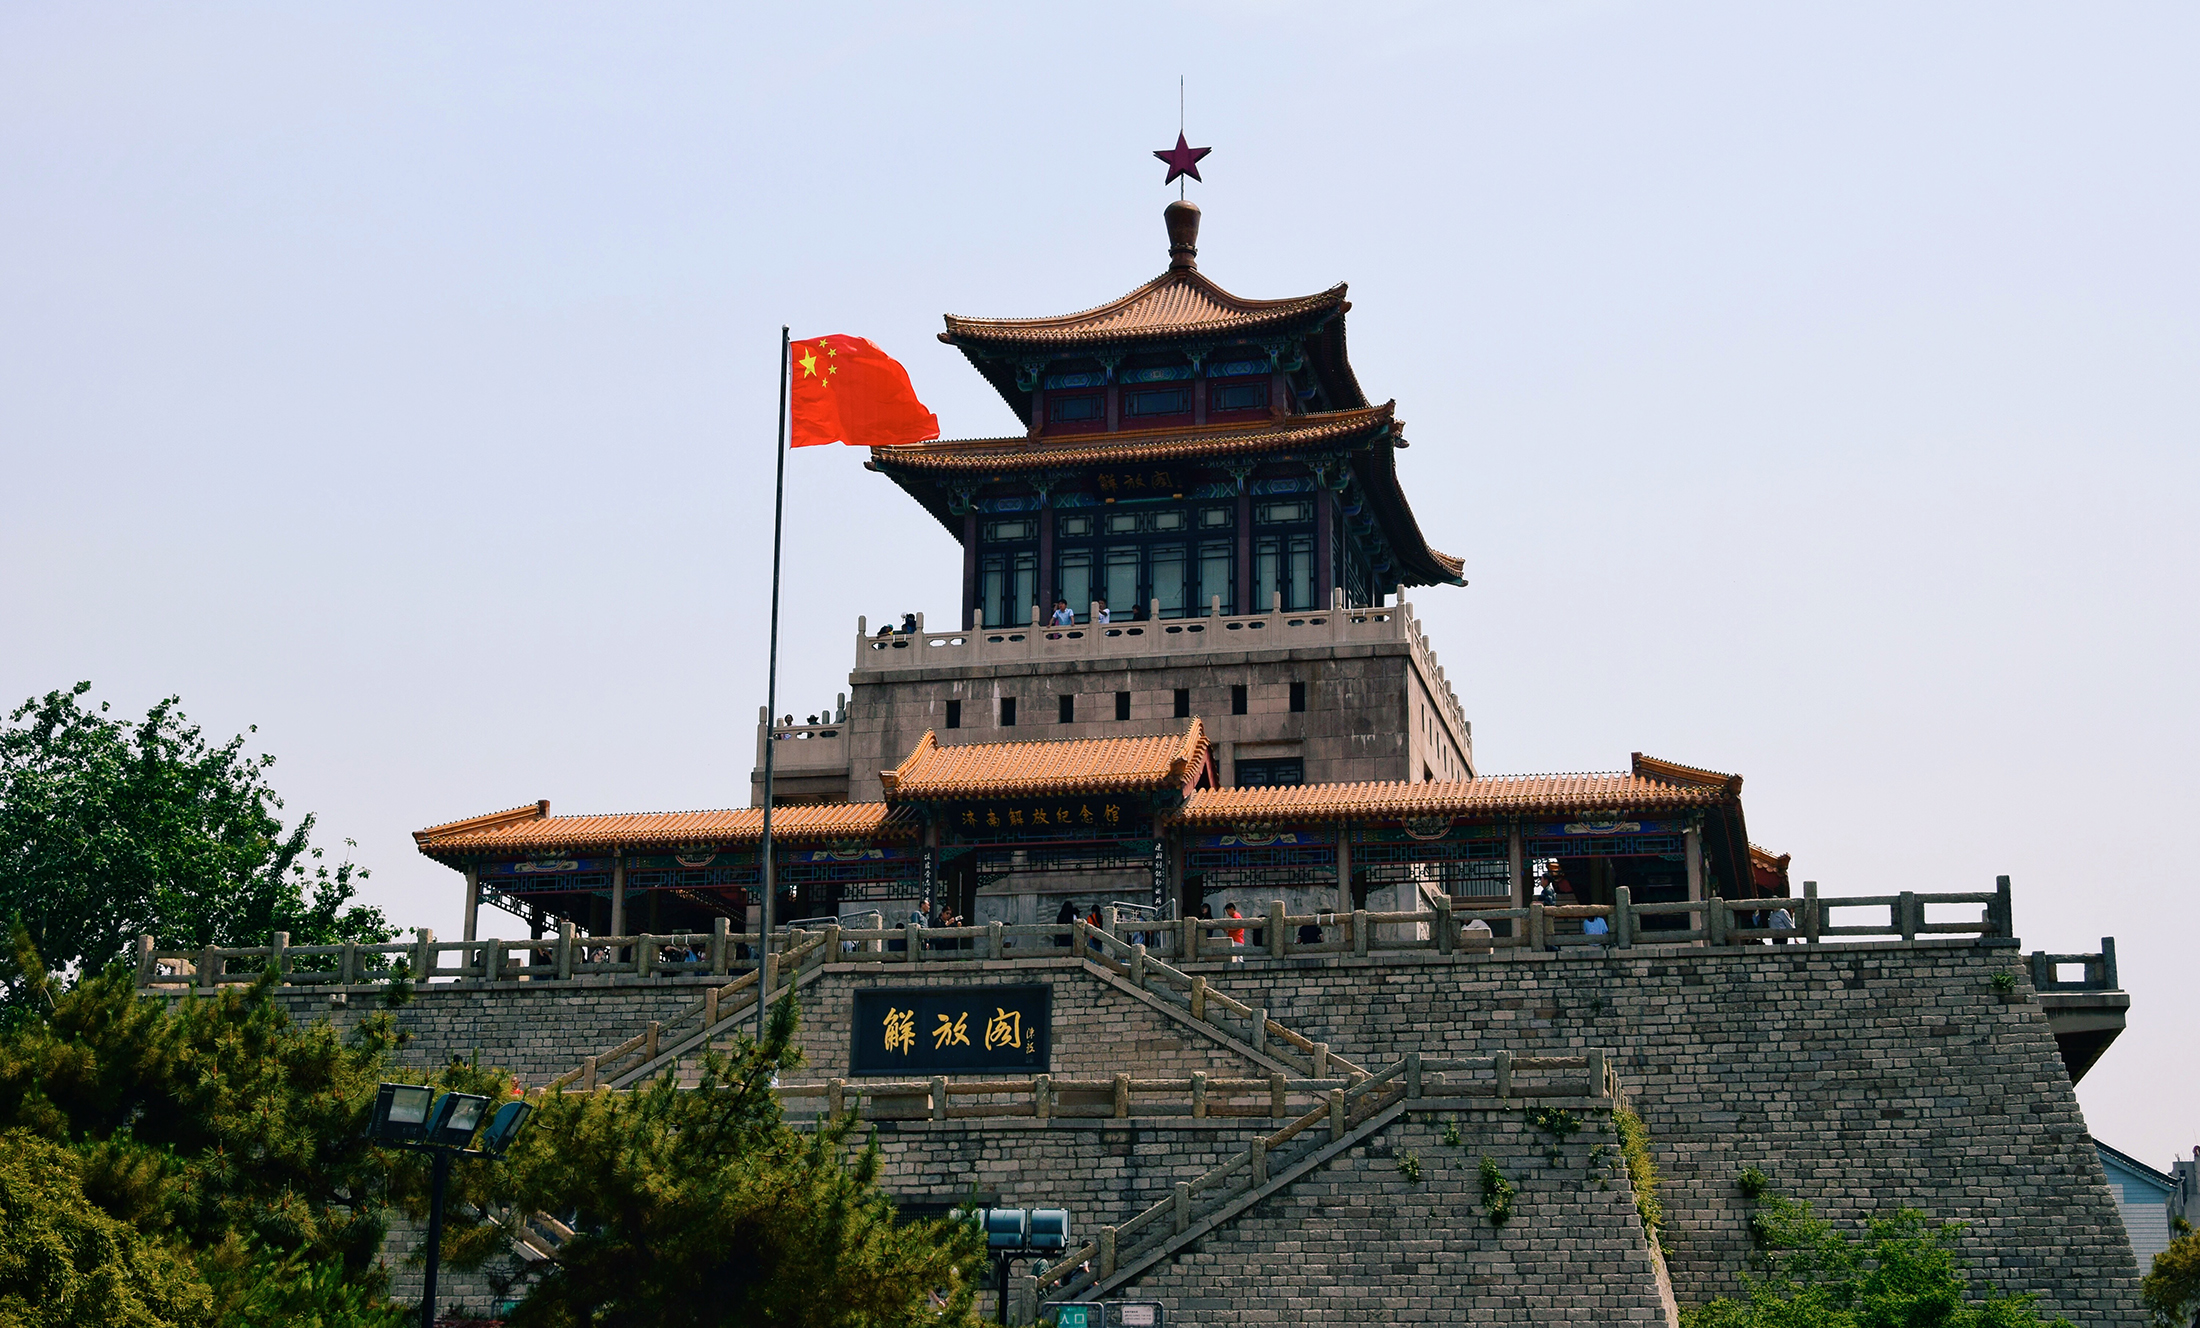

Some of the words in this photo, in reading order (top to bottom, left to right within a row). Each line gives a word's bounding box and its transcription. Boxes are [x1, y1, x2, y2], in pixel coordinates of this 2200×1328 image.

[961, 804, 1121, 828] 济南解放纪念馆
[882, 1006, 1022, 1056] 解放阁
[1060, 1313, 1085, 1325] 入口
